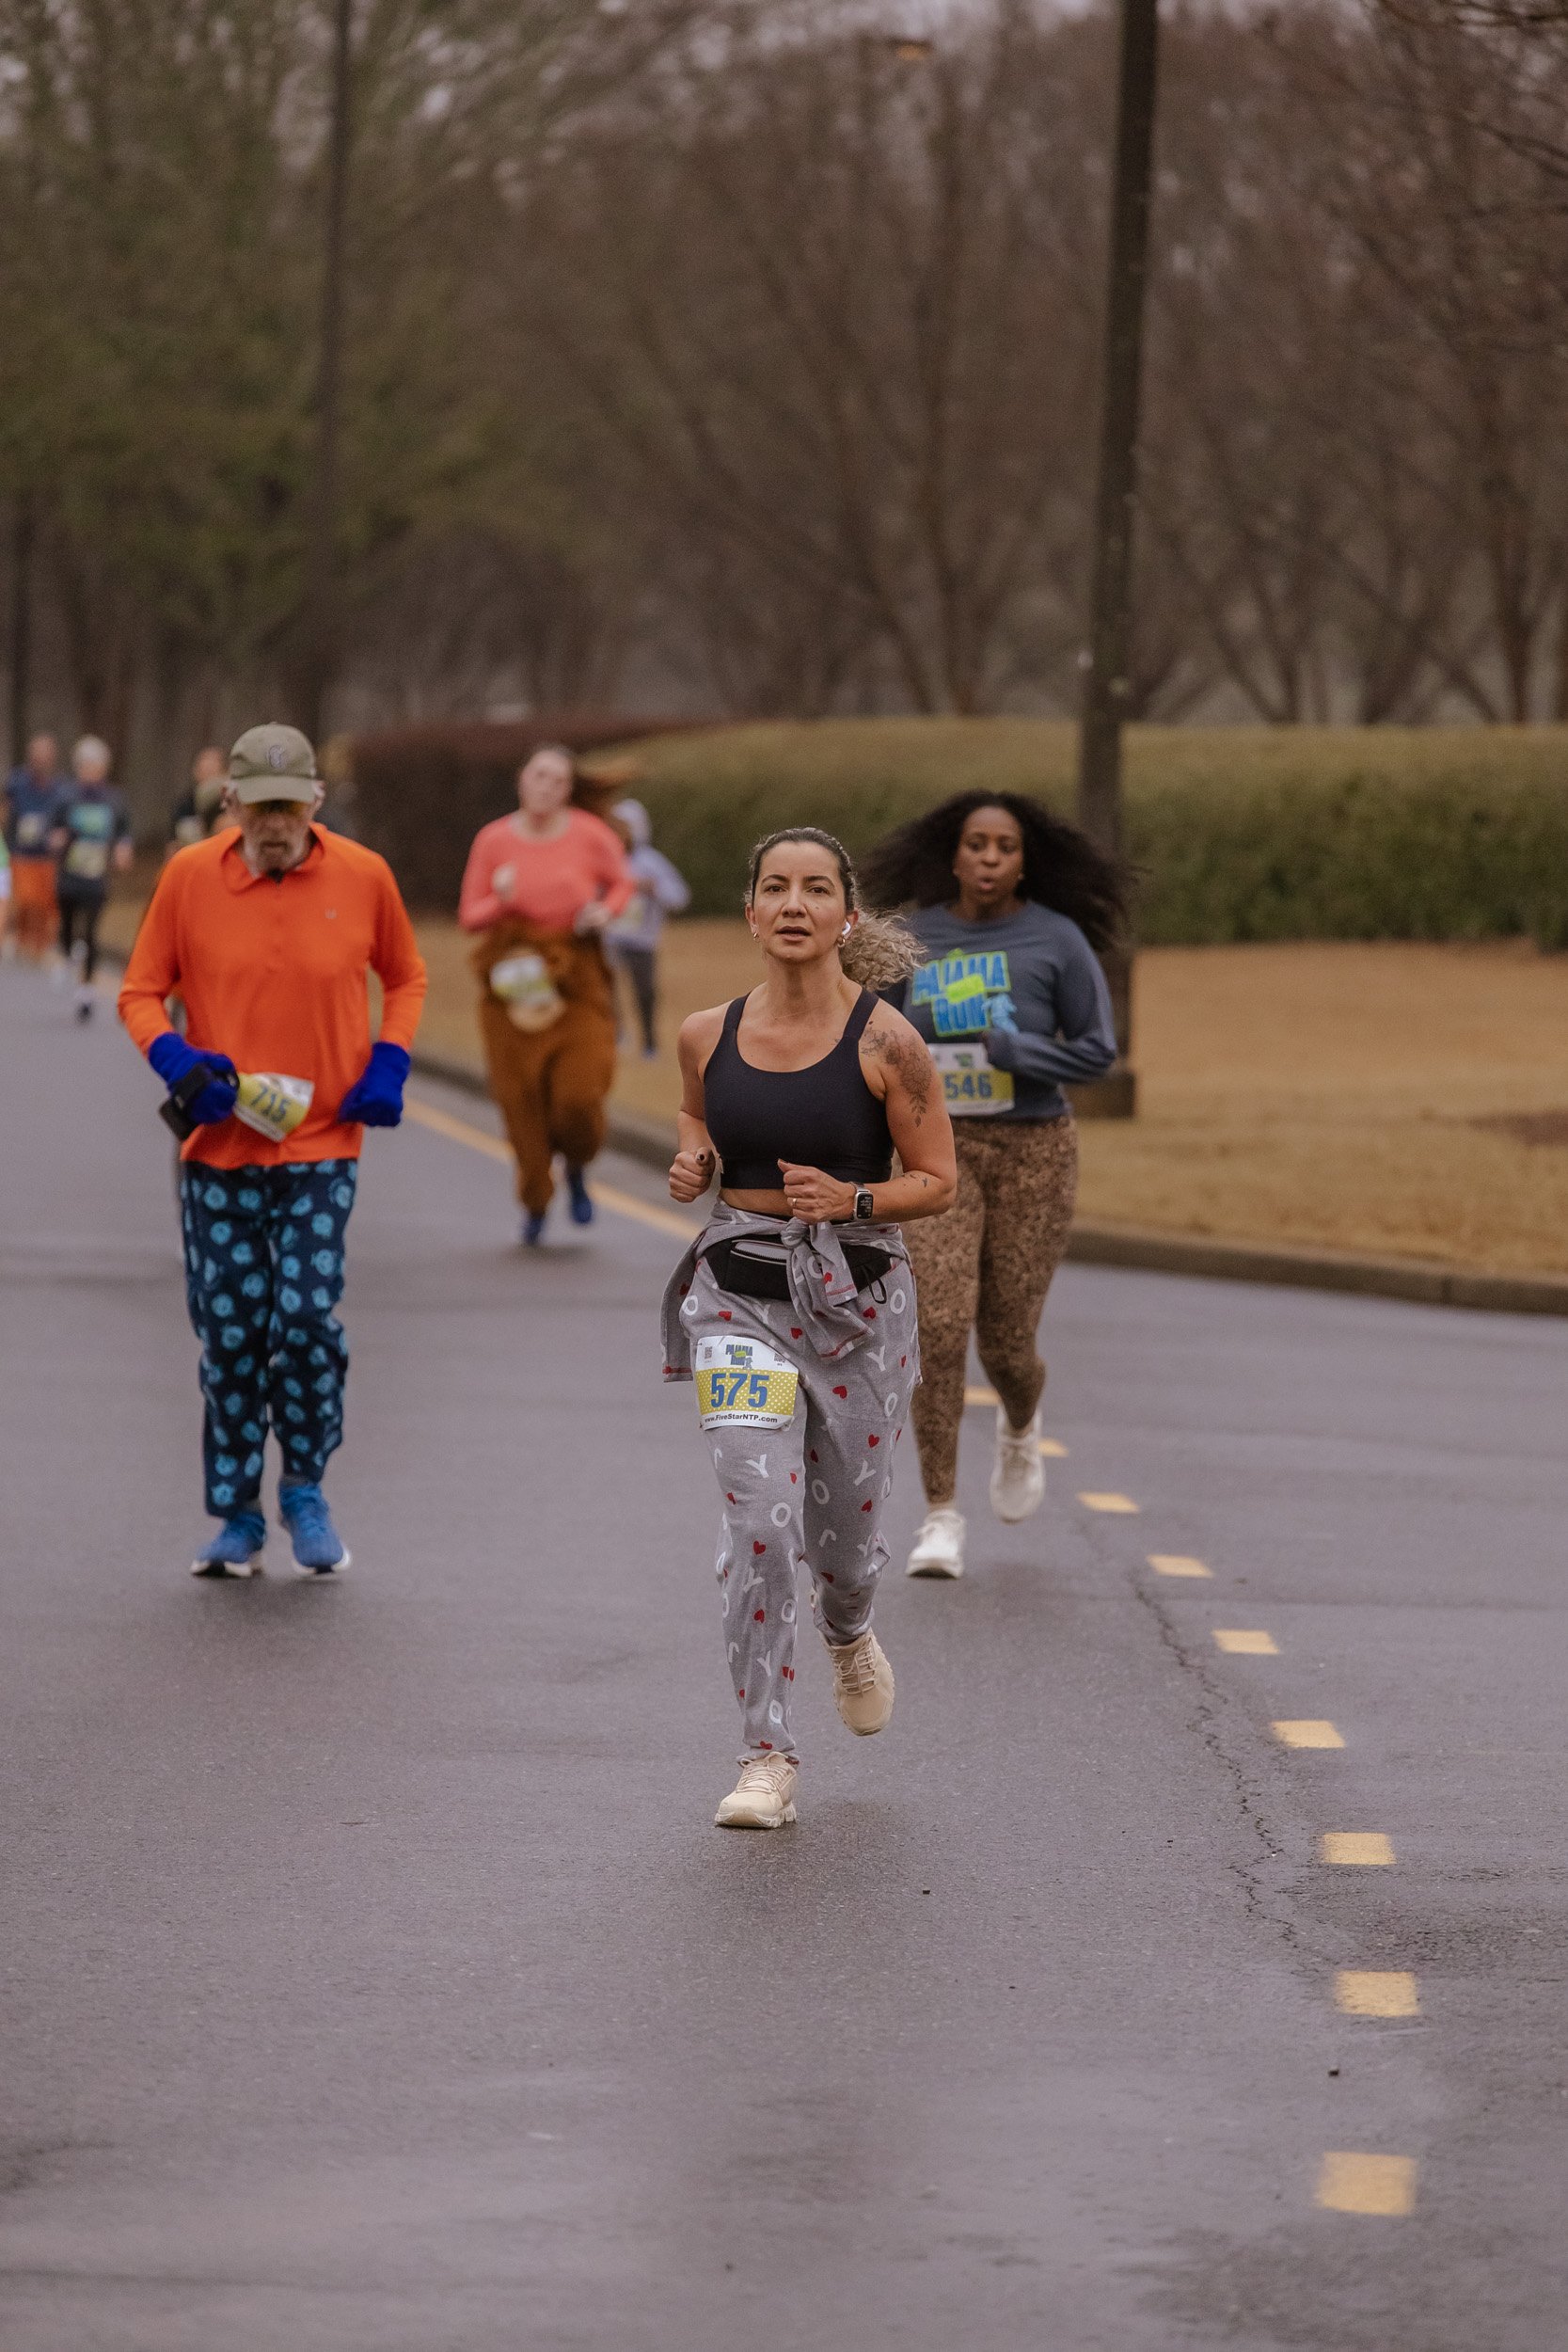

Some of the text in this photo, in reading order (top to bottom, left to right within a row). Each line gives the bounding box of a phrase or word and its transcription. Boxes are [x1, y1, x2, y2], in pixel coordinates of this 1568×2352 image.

[933, 993, 988, 1034] RUN
[943, 1073, 993, 1100] 546
[710, 1373, 770, 1408] 575
[705, 1413, 779, 1423] www.FiveStarNTP.com
